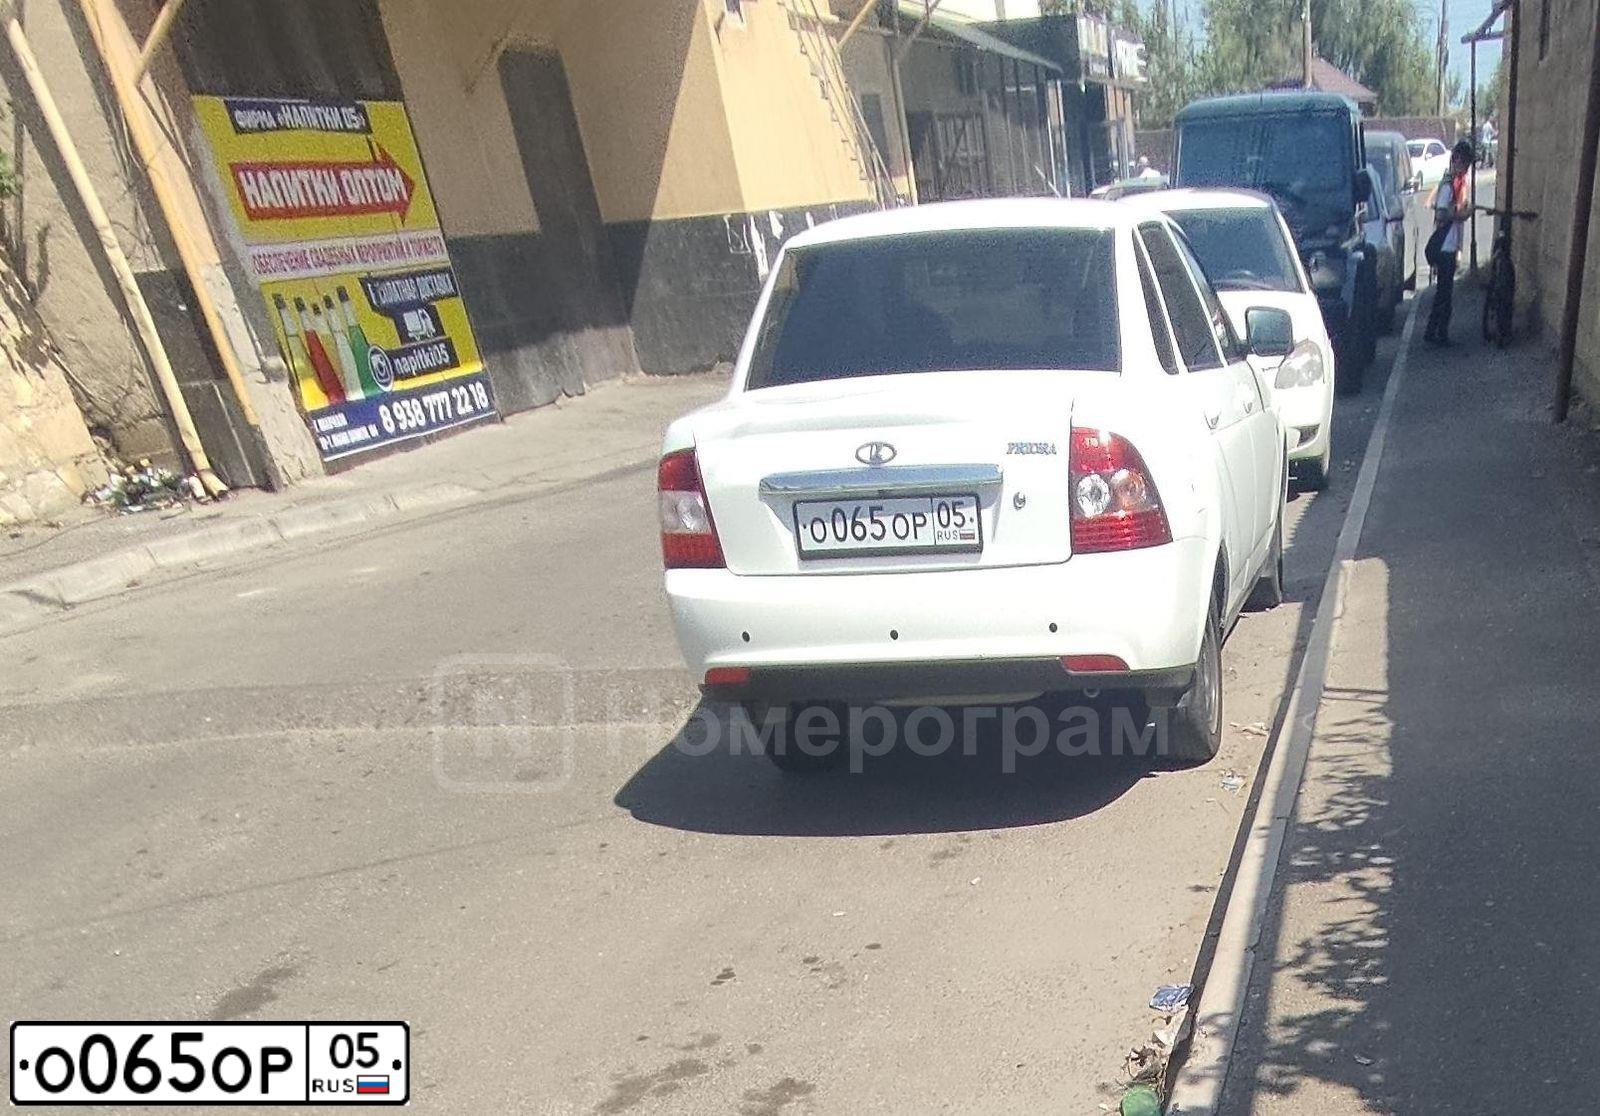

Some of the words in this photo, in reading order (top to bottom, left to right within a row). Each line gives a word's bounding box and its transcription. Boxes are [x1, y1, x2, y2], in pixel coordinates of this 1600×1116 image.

[234, 110, 277, 130] ФИРМА
[238, 168, 343, 210] НАПИТКИ
[339, 167, 409, 206] ОПТОМ
[367, 279, 419, 307] СПЛАТНАЯ
[393, 342, 450, 376] napitki05
[378, 404, 396, 434] 8
[392, 398, 426, 430] 938
[422, 391, 453, 423] 777
[451, 385, 474, 415] 22
[468, 381, 489, 410] 18
[1005, 441, 1057, 456] PRIORA
[937, 501, 966, 529] 05
[937, 532, 958, 541] RUS
